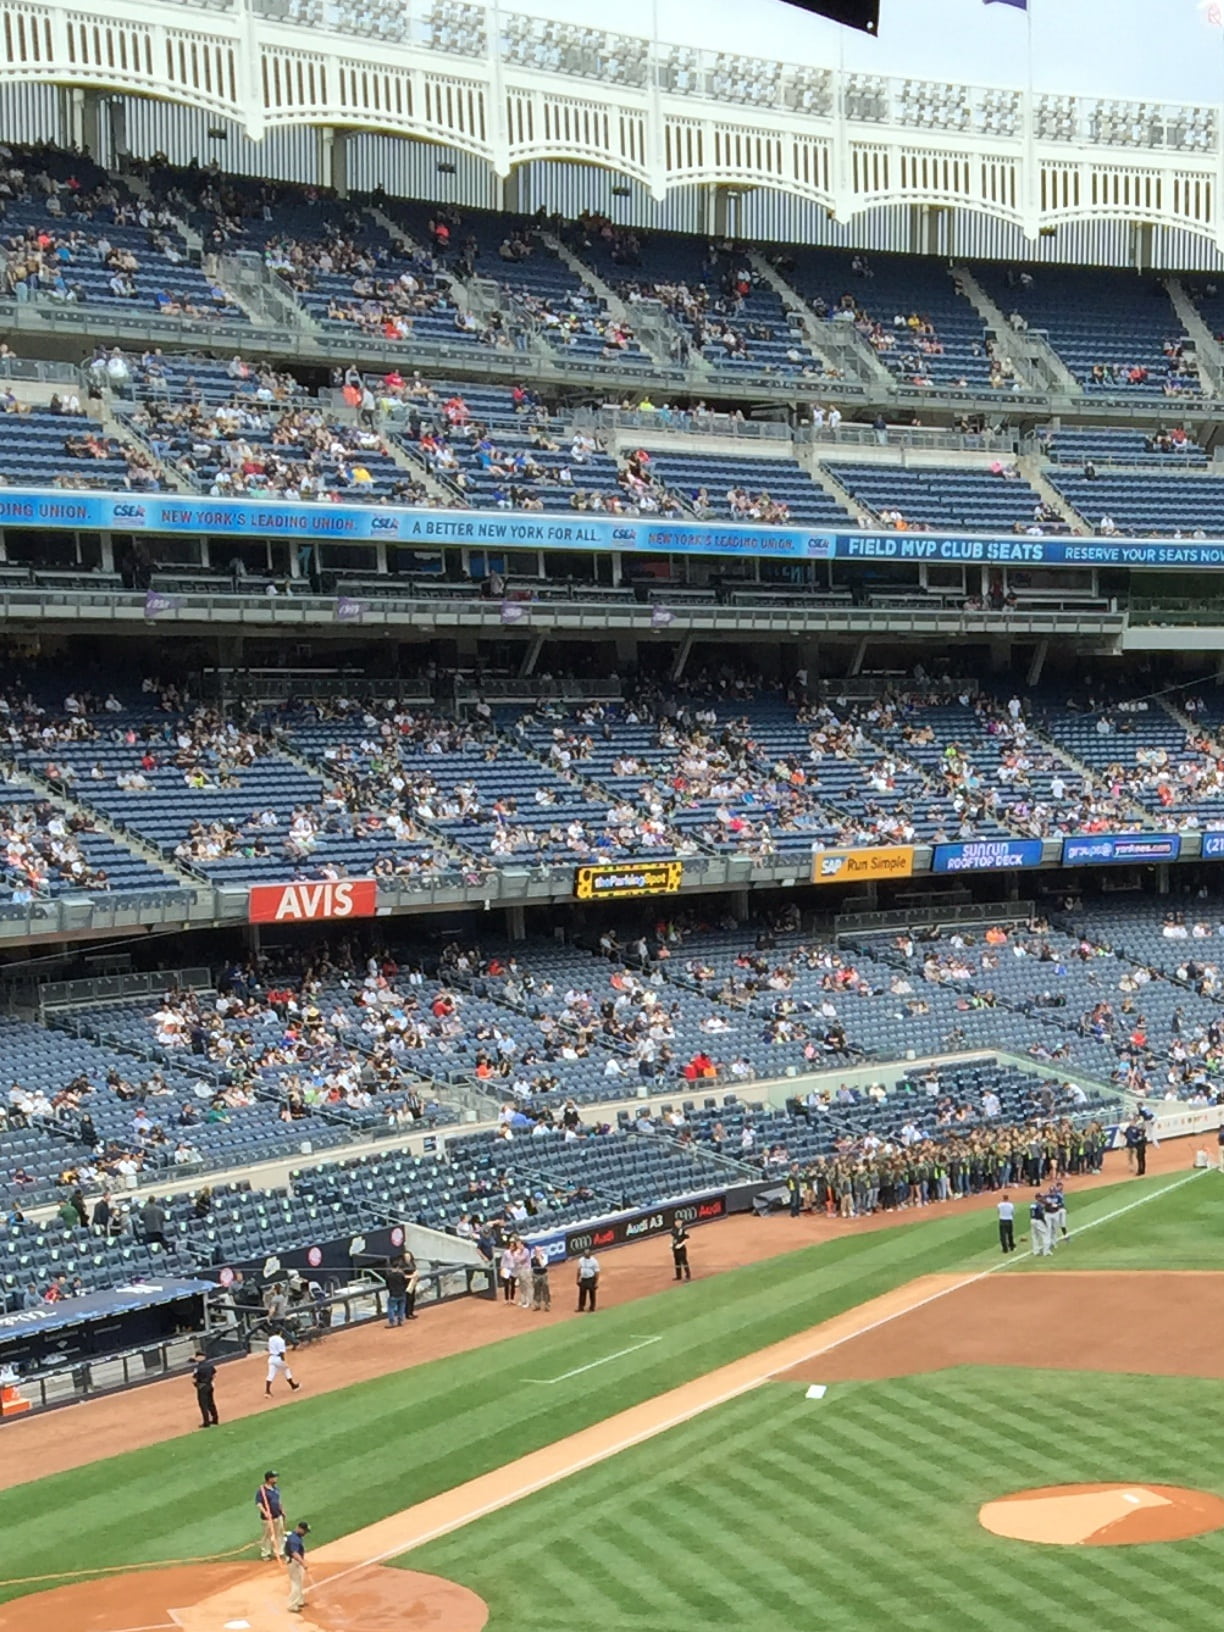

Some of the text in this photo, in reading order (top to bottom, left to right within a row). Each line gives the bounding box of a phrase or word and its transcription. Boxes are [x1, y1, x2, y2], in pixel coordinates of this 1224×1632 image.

[113, 504, 146, 518] CSEA
[161, 508, 192, 523] NEW
[197, 511, 246, 526] YORK'S
[251, 513, 307, 529] LEADING
[371, 516, 398, 530] CSEA
[412, 520, 422, 534] A
[426, 521, 474, 537] BETTER
[478, 523, 508, 538] NEW
[511, 525, 544, 539] YORK
[548, 527, 572, 541] FOR
[612, 528, 636, 541] CSEA
[808, 537, 829, 550] CSEA
[849, 537, 1044, 560] FIELD MVP CLUB SEATS
[1065, 547, 1119, 561] RESERVE
[1122, 548, 1156, 562] YOUR
[1158, 549, 1198, 562] SEATS
[821, 855, 907, 876] SAP Run Simple
[947, 854, 1024, 870] ROOFTOP DECK
[275, 881, 353, 921] AVIS
[699, 1201, 722, 1217] Audi
[626, 1214, 663, 1237] Audi A3
[593, 1230, 614, 1245] Audi
